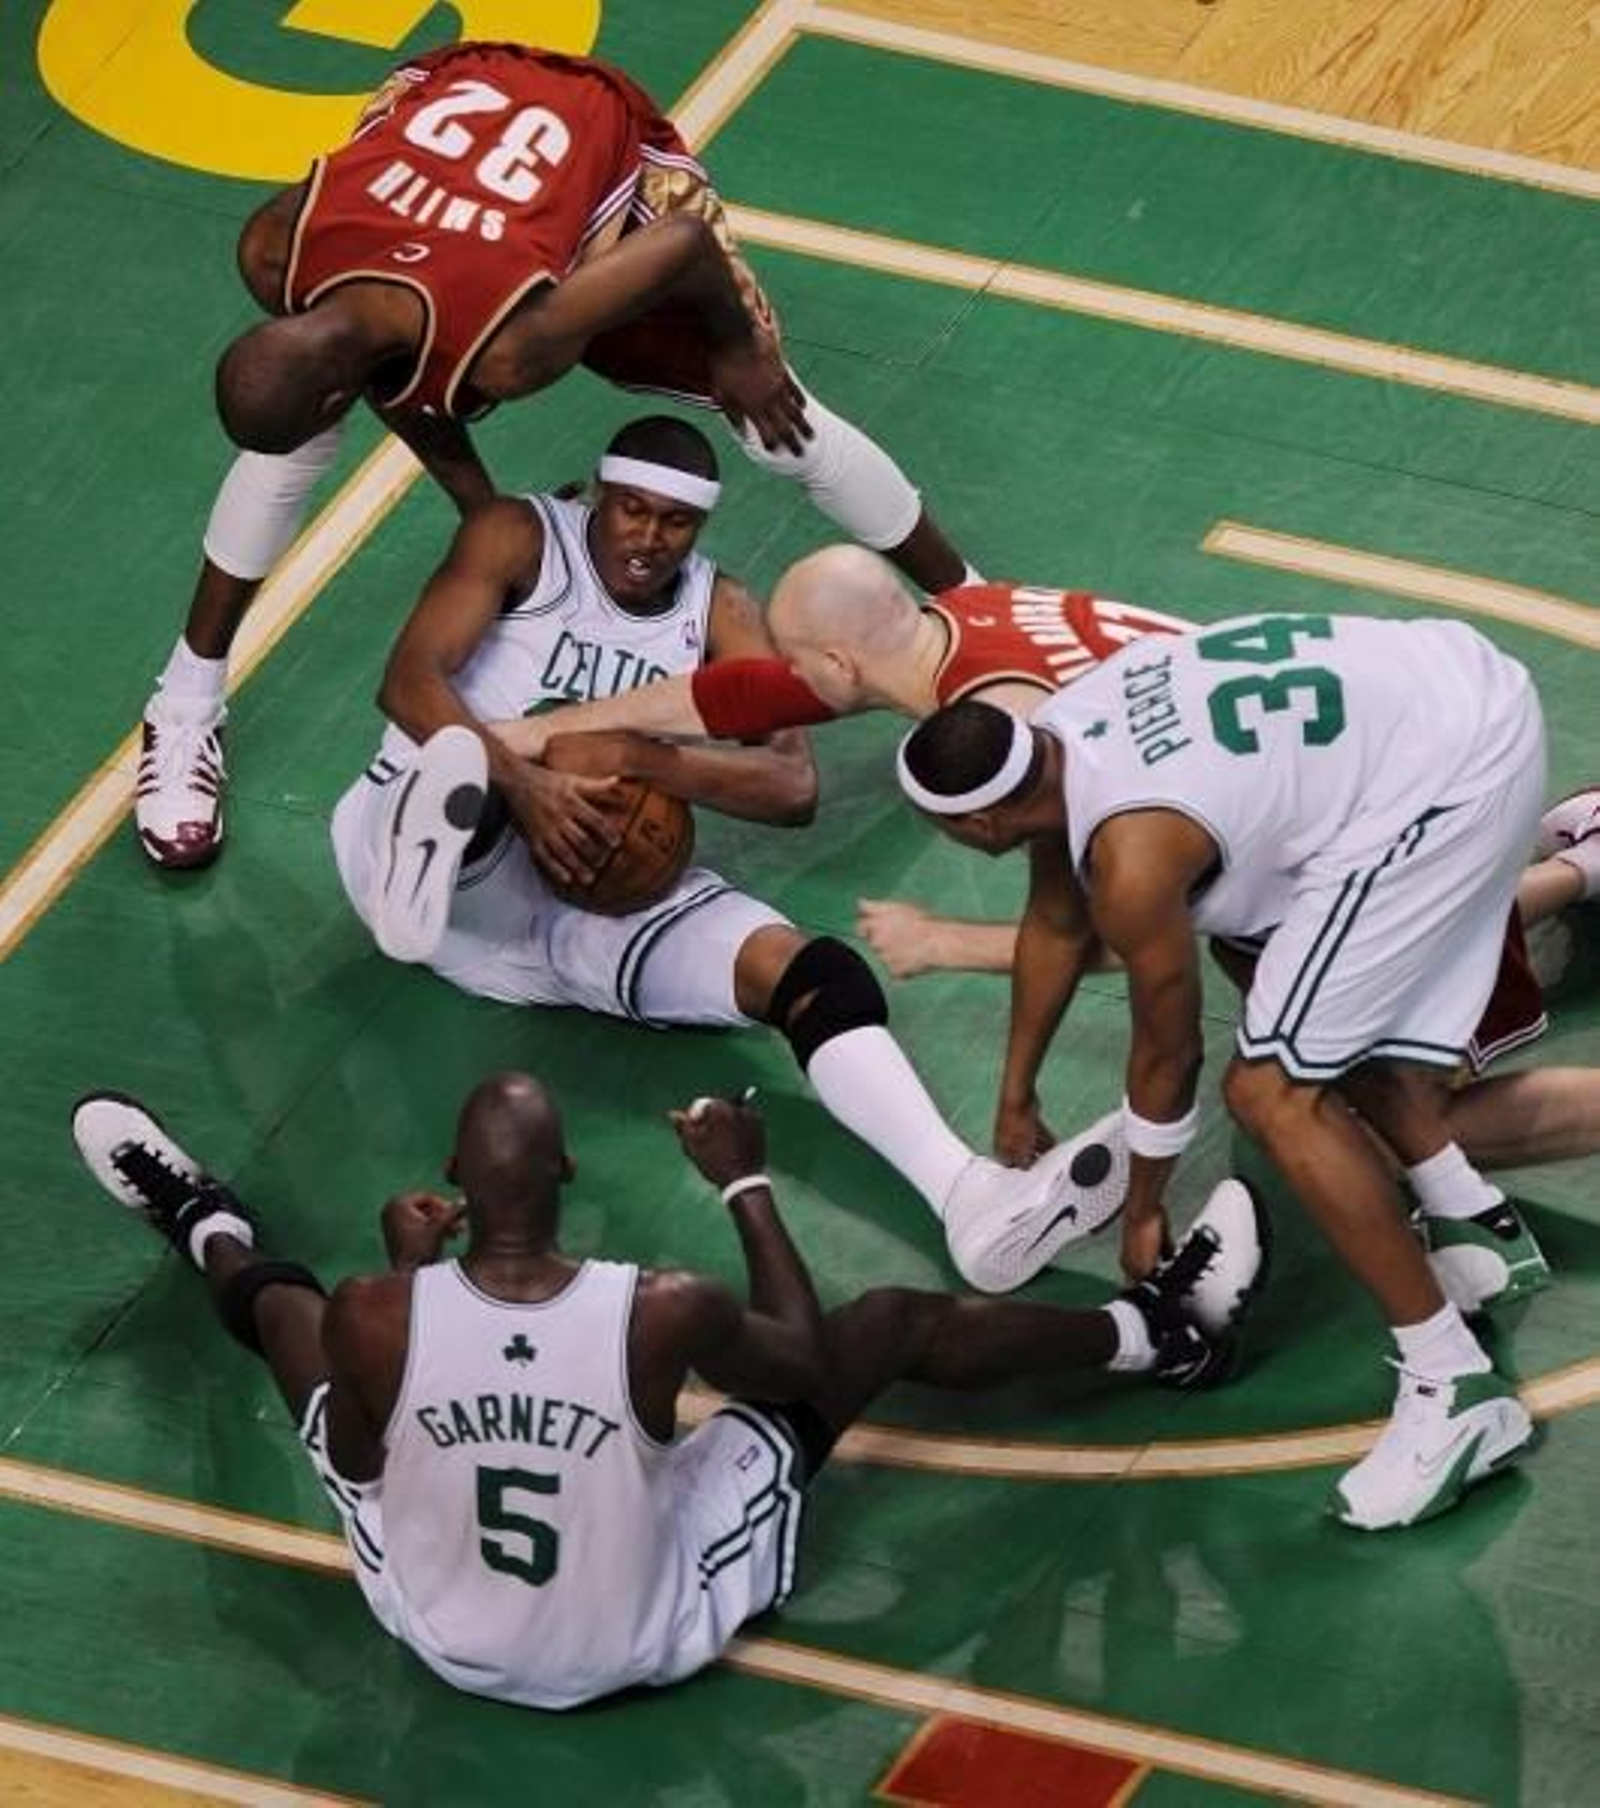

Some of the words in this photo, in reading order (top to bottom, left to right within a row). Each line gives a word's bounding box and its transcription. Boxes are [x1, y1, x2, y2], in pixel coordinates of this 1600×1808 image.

[404, 80, 571, 204] 32
[366, 160, 506, 241] SMITH
[1123, 655, 1192, 766] PIERCE
[1197, 617, 1346, 755] 34
[416, 1394, 620, 1458] GARNETT
[477, 1466, 560, 1587] 5
